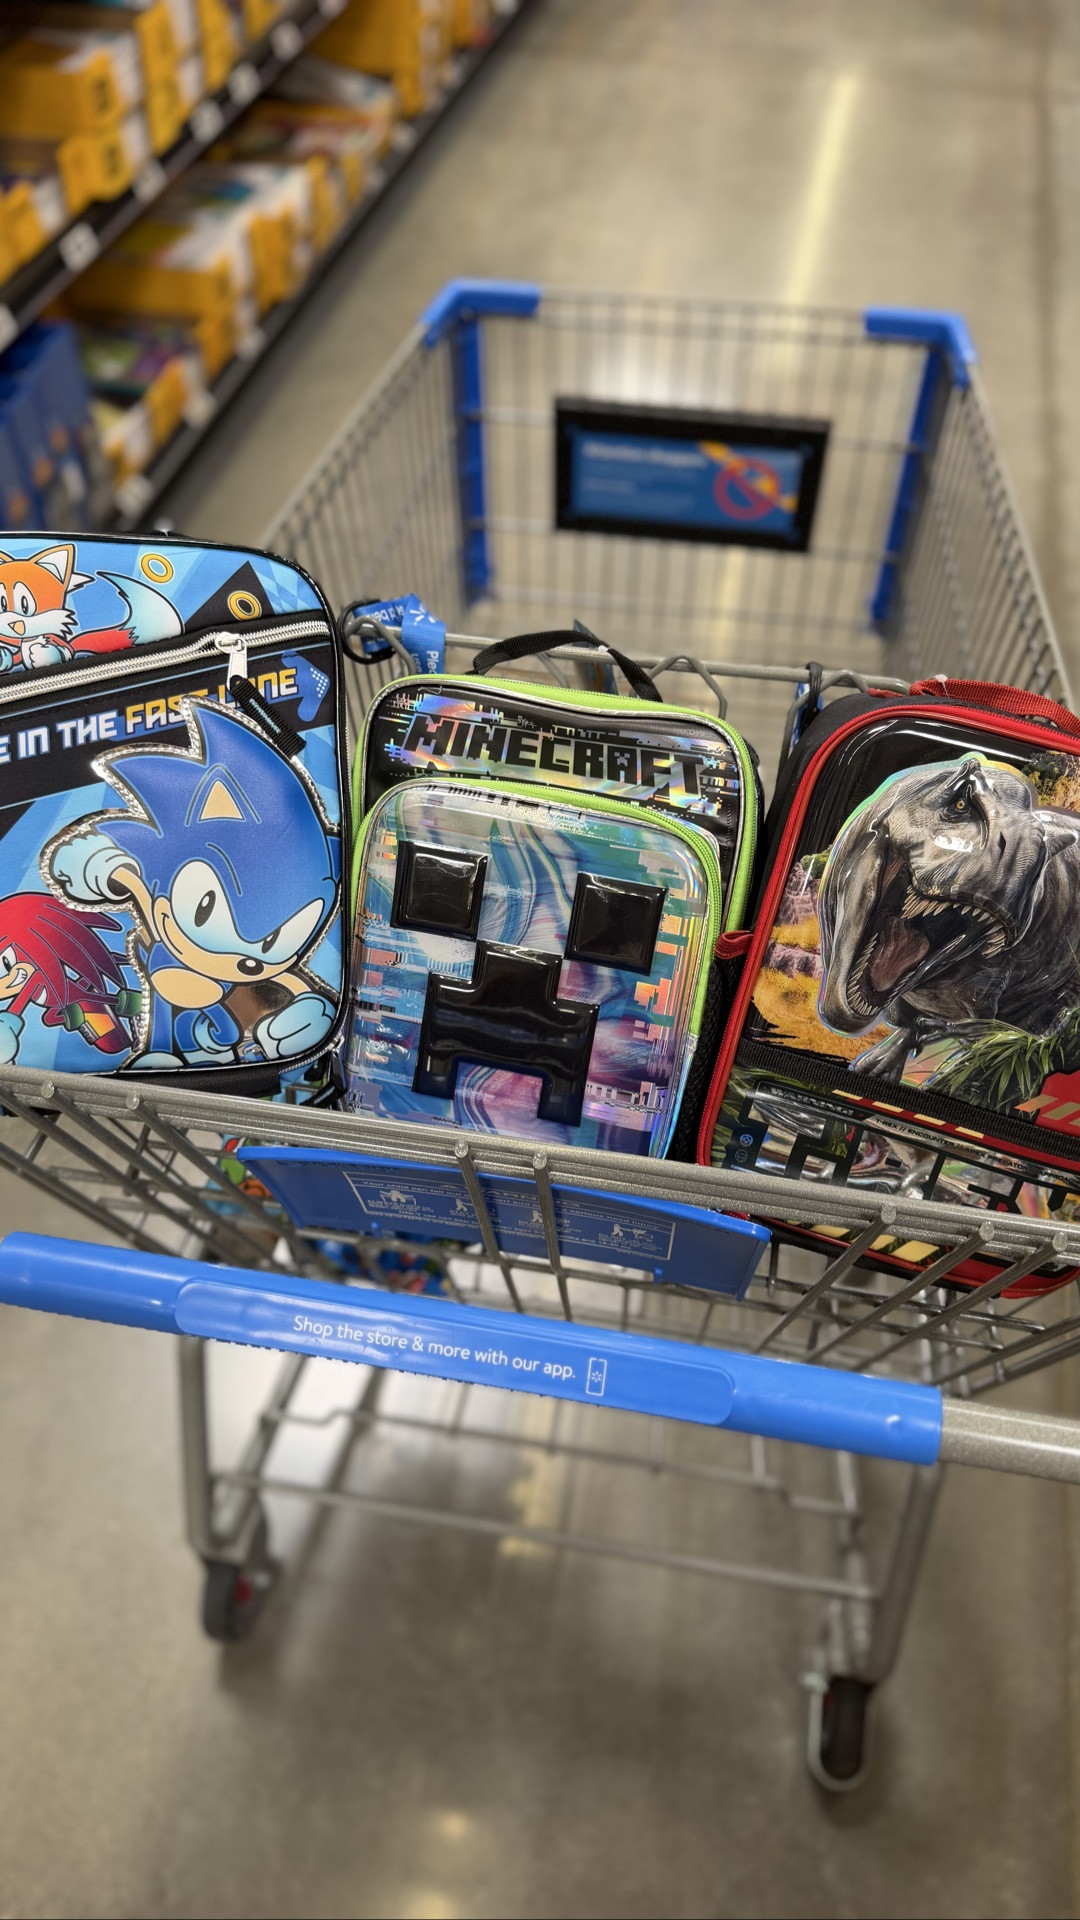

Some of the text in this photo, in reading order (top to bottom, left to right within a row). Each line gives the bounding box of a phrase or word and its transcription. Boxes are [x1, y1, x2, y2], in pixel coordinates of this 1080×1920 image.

[19, 727, 49, 759] IN
[57, 711, 118, 749] THE
[218, 668, 298, 709] LNE
[403, 712, 704, 796] MINECRAFT
[771, 1087, 854, 1115] WARNING!
[876, 1118, 898, 1129] T-REX
[907, 1128, 955, 1146] ENCOUNTER
[293, 1315, 576, 1380] Shop the store & more with our app.
